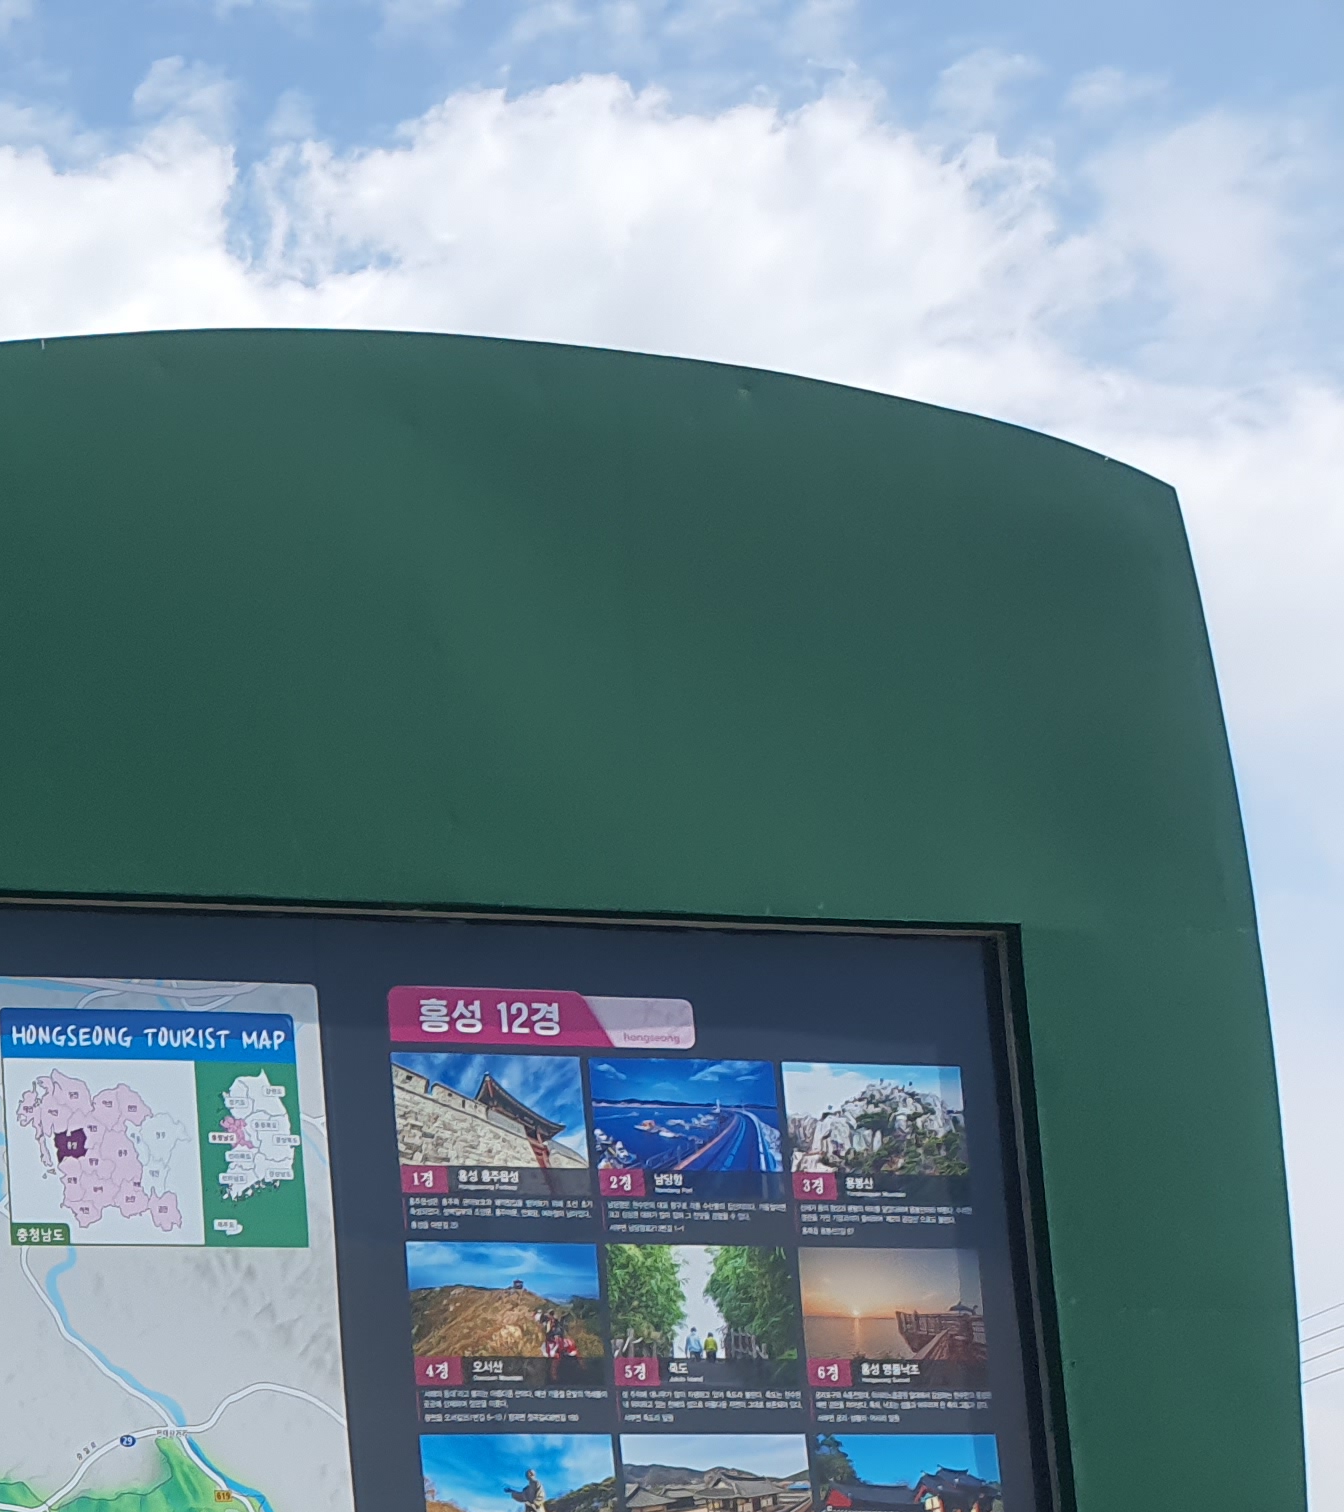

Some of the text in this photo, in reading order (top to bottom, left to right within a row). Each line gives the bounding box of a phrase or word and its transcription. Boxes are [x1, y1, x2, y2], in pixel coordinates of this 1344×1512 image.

[418, 999, 560, 1035] 홍성 12경
[12, 1026, 285, 1051] HONGSEONG TOURIST MAP
[411, 1170, 435, 1189] 1경
[609, 1173, 683, 1192] 2경 남당항
[802, 1177, 873, 1194] 3경 용봉산
[17, 1227, 64, 1243] 충청남도
[425, 1360, 502, 1380] 4경 오서산
[624, 1363, 646, 1381] 5경
[817, 1365, 839, 1382] 6경
[121, 1436, 134, 1447] 29
